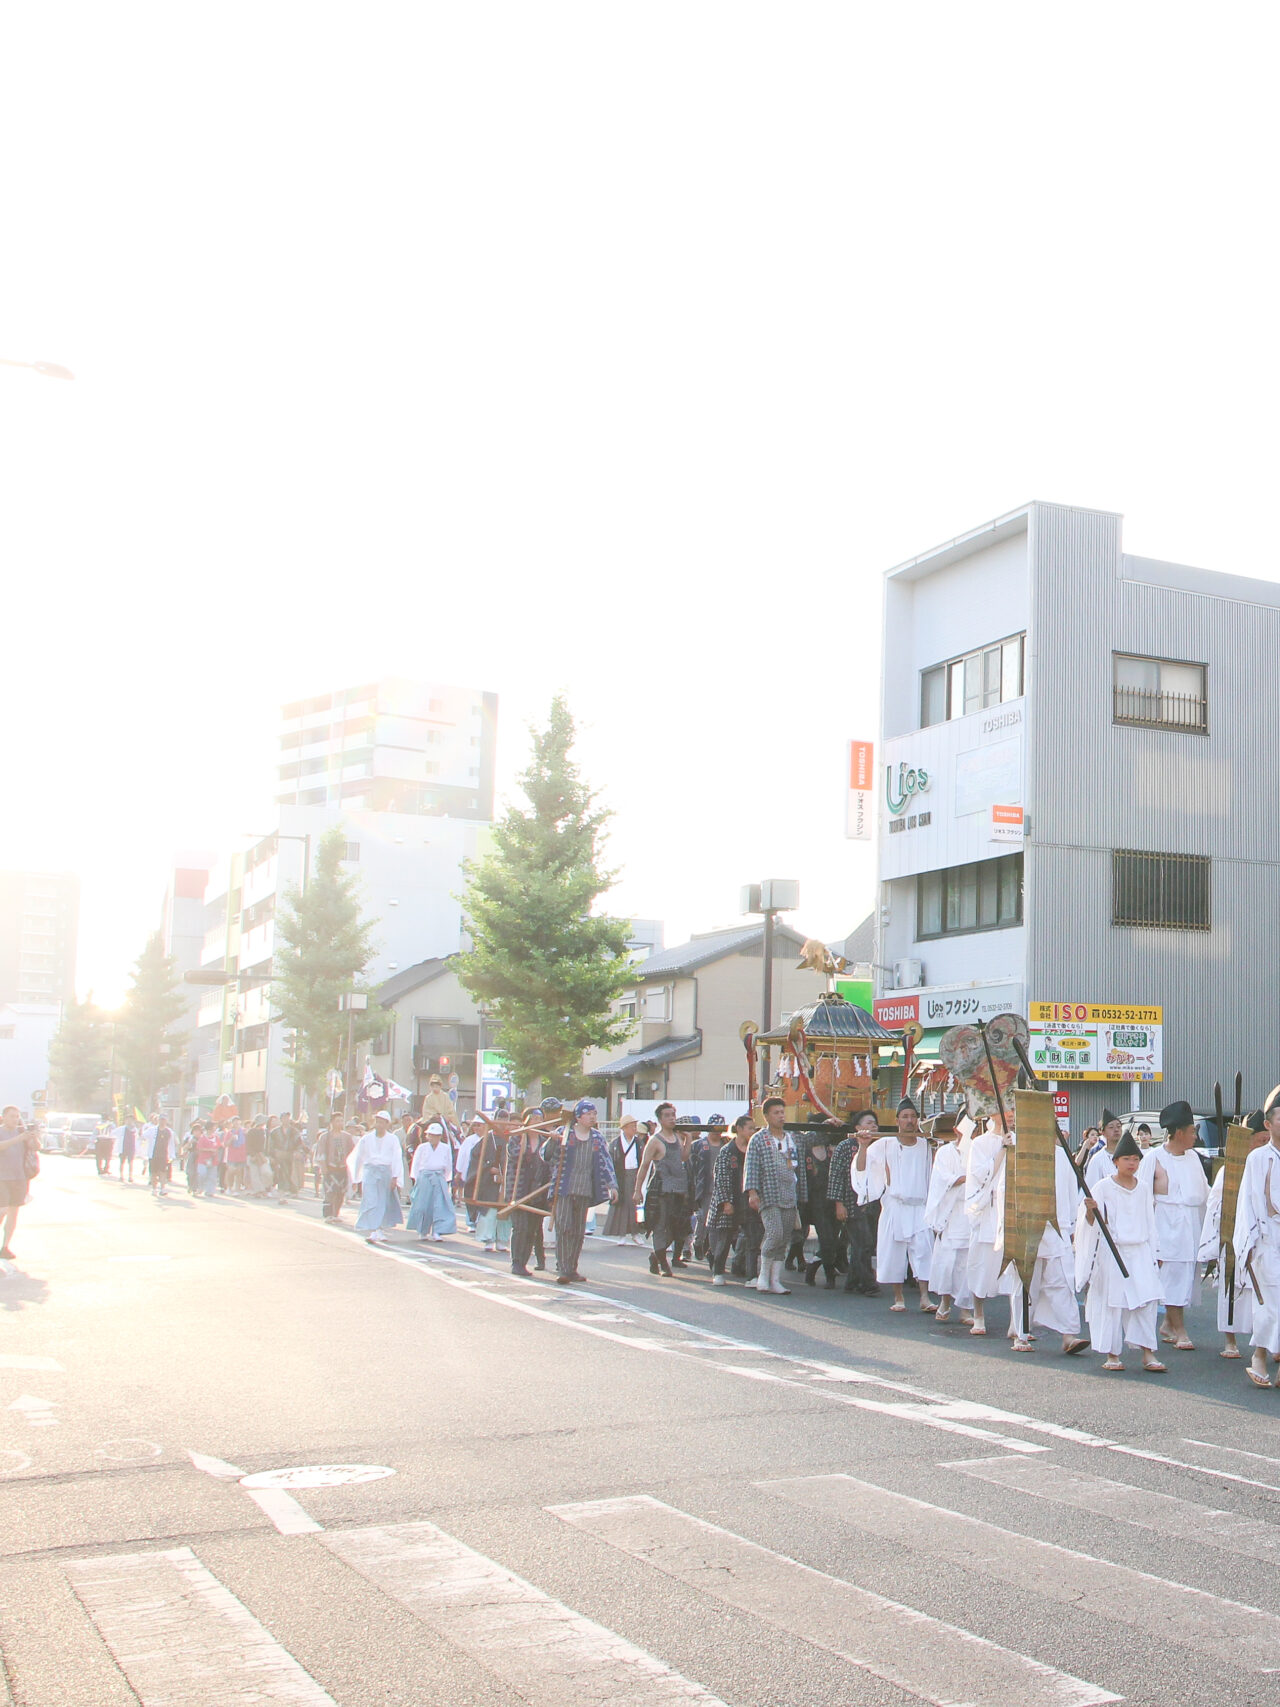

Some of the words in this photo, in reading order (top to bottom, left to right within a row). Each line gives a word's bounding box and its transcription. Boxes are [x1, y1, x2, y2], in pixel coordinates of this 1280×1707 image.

[983, 709, 1022, 733] TOSHIBA
[858, 747, 866, 786] TOSHIBA
[878, 1005, 915, 1021] TOSHIBA
[945, 999, 980, 1015] フクジン
[1053, 1004, 1088, 1021] ISO
[1101, 1010, 1158, 1020] 0532-52-1771
[1036, 1052, 1090, 1063] 人財派遣
[485, 1084, 508, 1110] P
